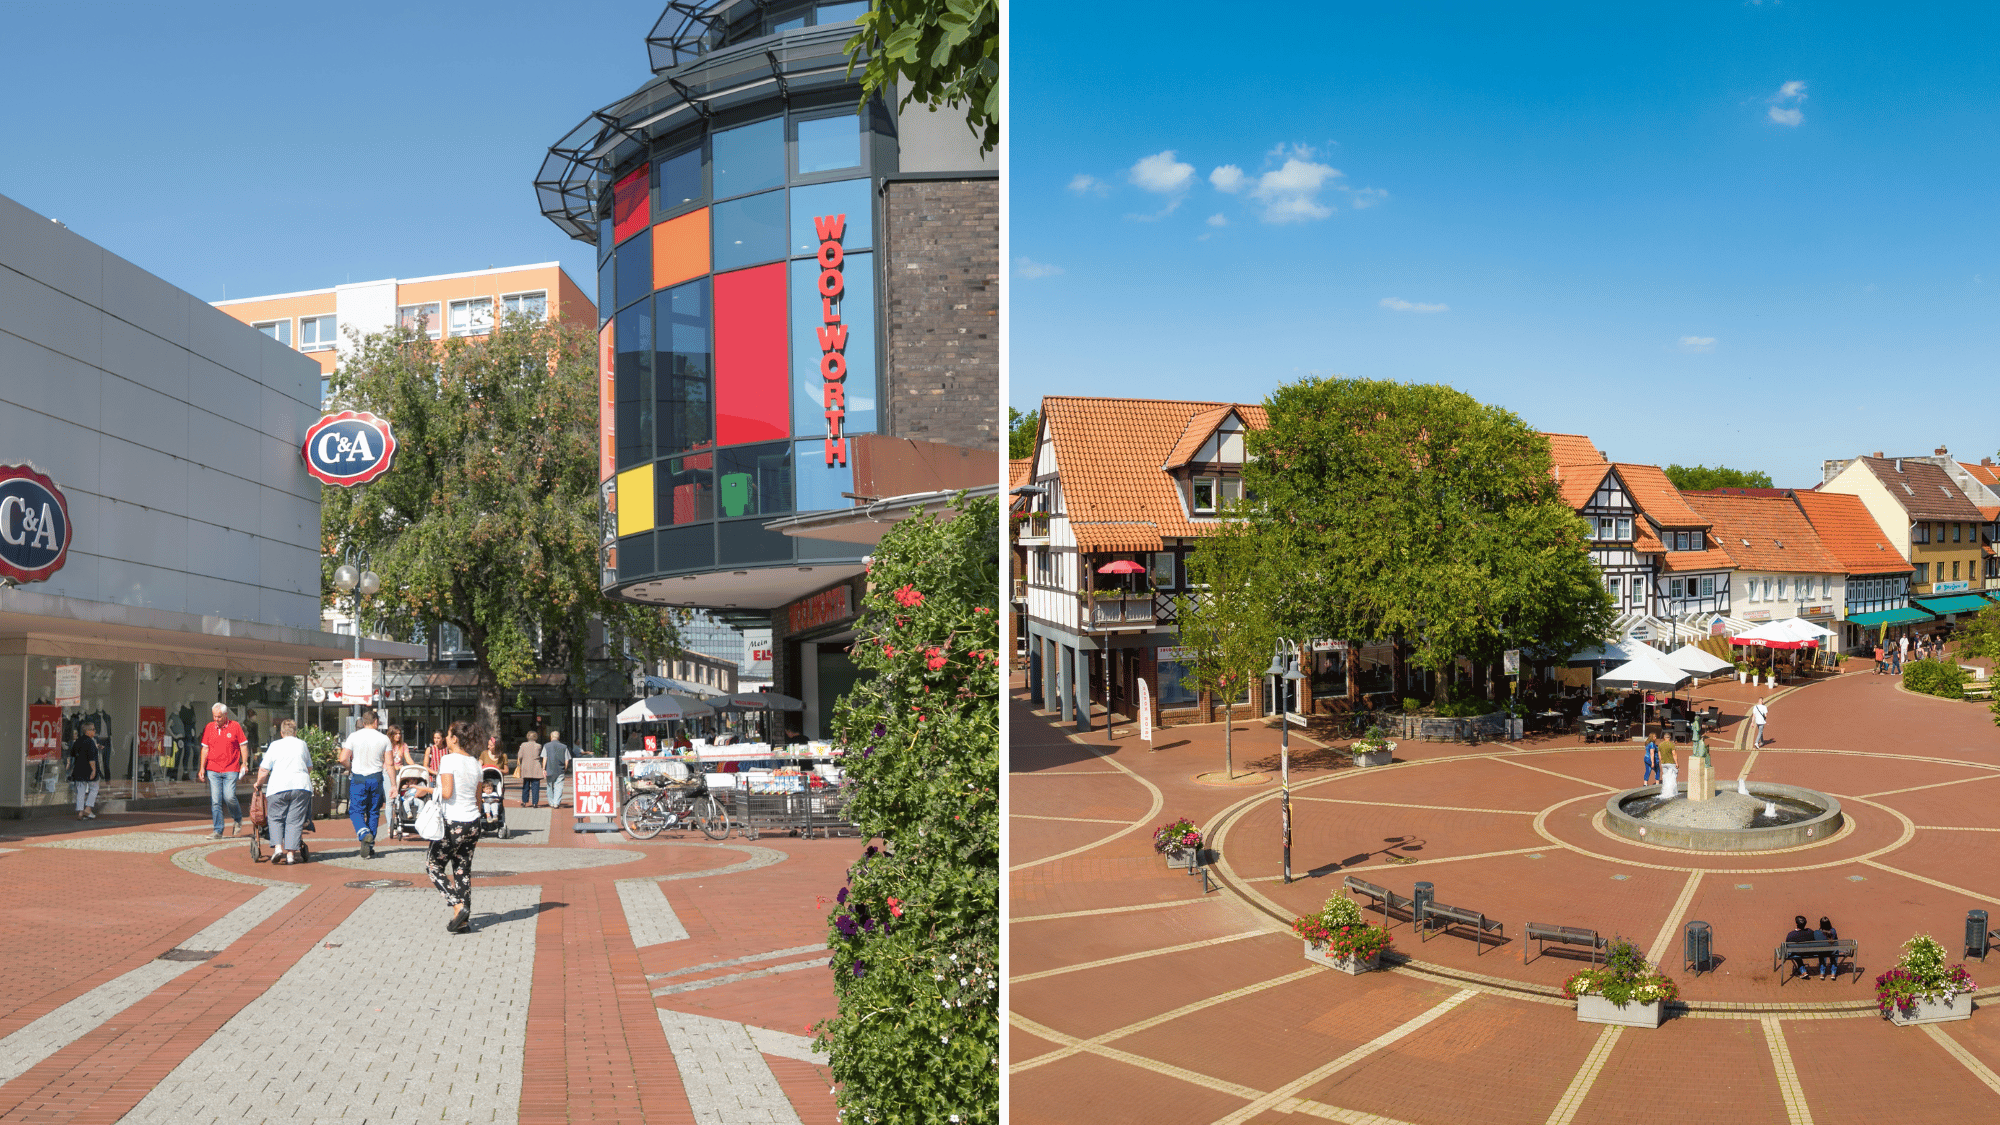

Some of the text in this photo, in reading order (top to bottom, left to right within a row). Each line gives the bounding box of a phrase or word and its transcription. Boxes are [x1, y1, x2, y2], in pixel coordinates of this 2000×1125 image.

[813, 214, 848, 464] WOOLWORTH
[318, 430, 375, 464] C&A
[0, 495, 58, 551] C&A
[748, 640, 767, 651] Mein
[140, 720, 164, 743] 50%
[577, 772, 612, 785] STARK
[579, 795, 611, 813] 70%
